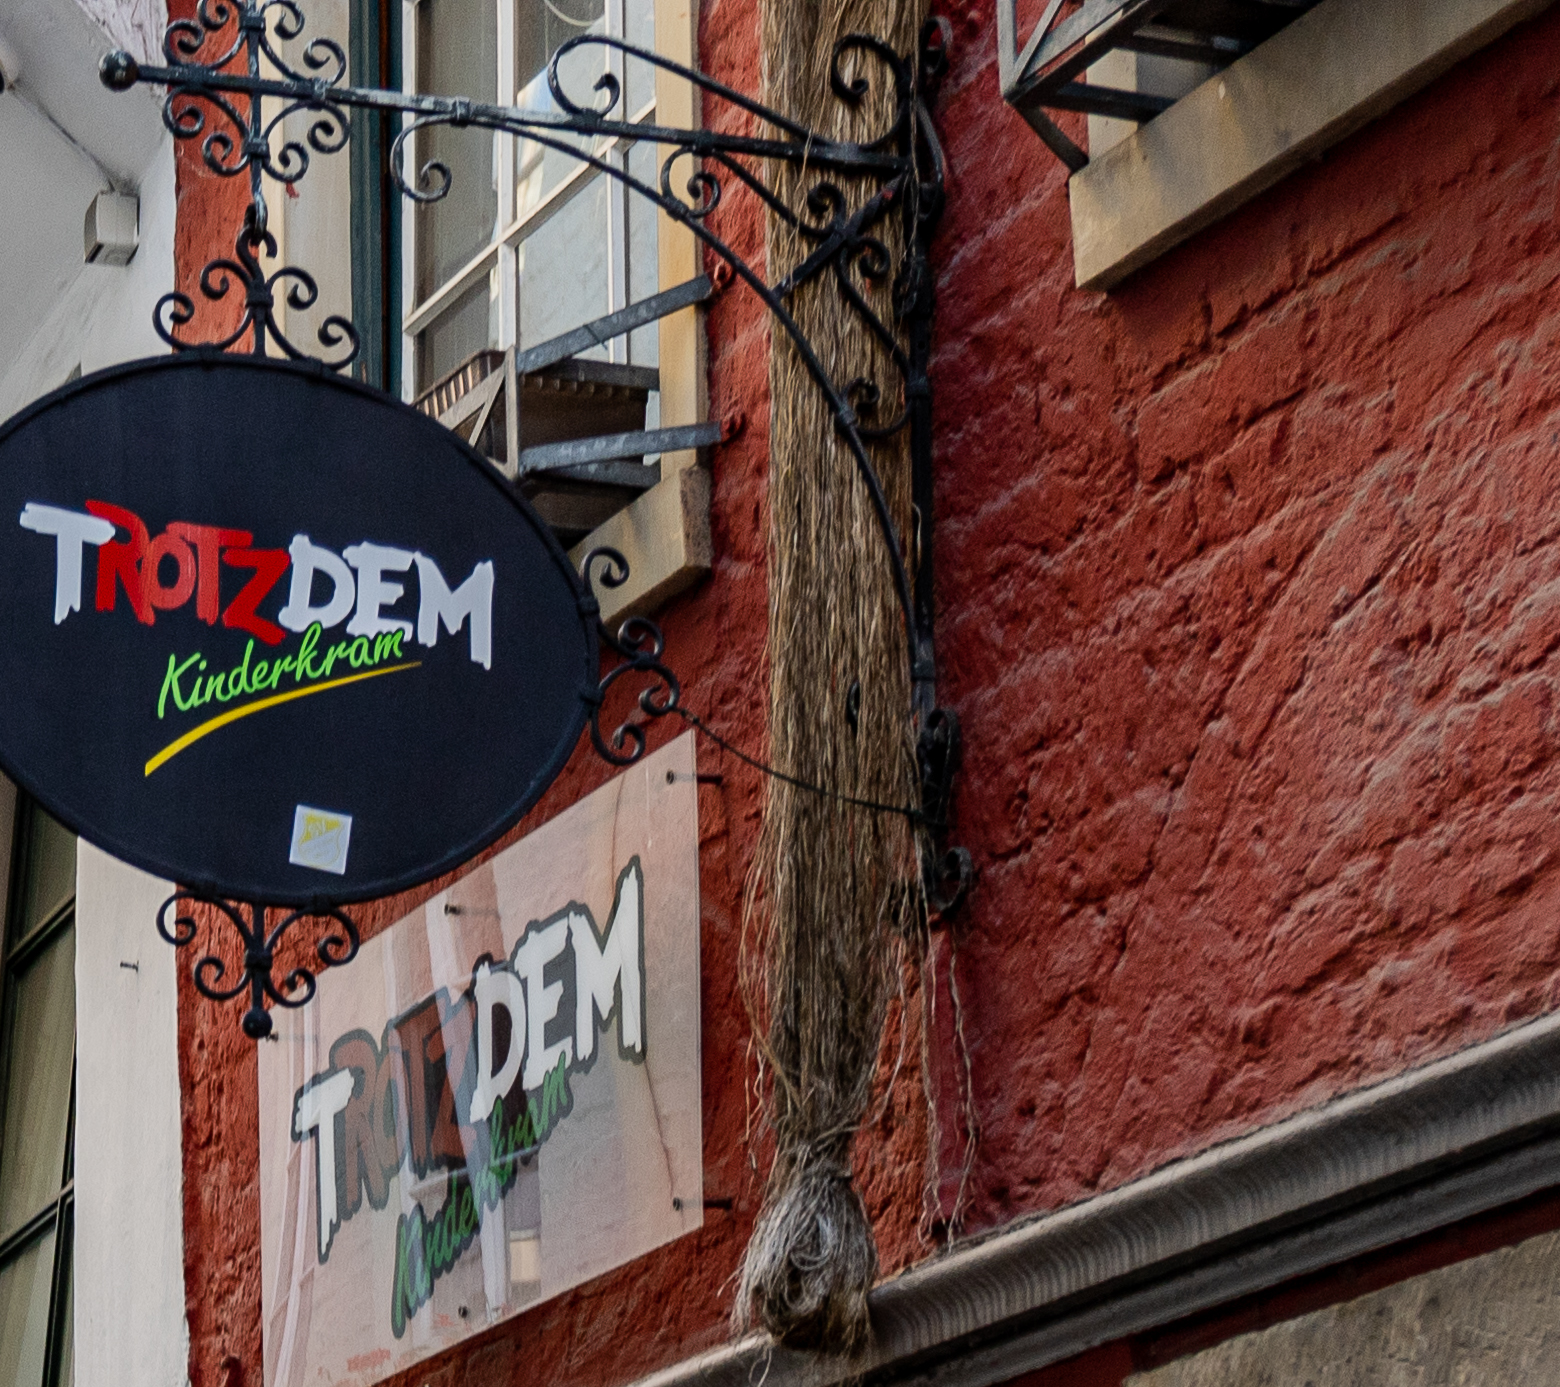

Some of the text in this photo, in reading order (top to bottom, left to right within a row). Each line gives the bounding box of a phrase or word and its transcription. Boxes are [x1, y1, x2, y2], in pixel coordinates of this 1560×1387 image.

[20, 499, 494, 670] TROTZDEM
[157, 622, 406, 719] Kinderkram
[292, 856, 645, 1263] TROTZDEM
